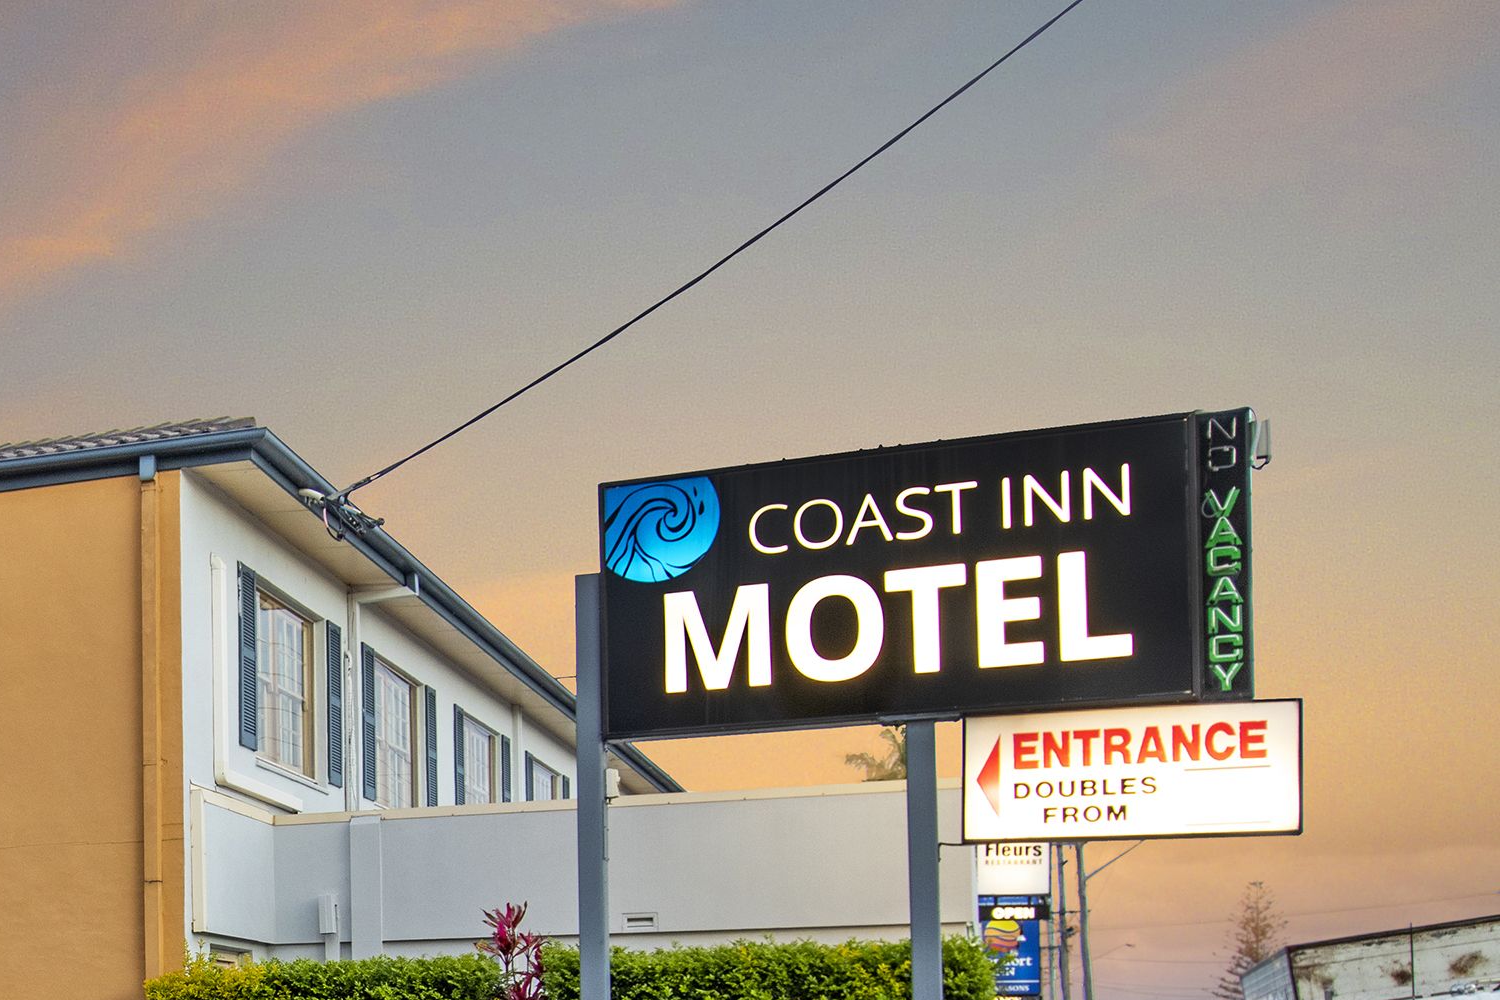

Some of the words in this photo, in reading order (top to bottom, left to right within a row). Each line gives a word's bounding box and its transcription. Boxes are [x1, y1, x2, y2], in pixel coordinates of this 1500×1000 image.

[1207, 416, 1236, 471] NO
[748, 481, 978, 554] COAST
[1002, 463, 1132, 528] INN
[1204, 486, 1244, 692] VACANCY
[663, 551, 1134, 693] MOTEL
[1013, 720, 1268, 769] ENTRANCE
[1013, 776, 1158, 799] DOUBLES
[1043, 804, 1128, 825] FROM
[985, 843, 1042, 857] Fleurs
